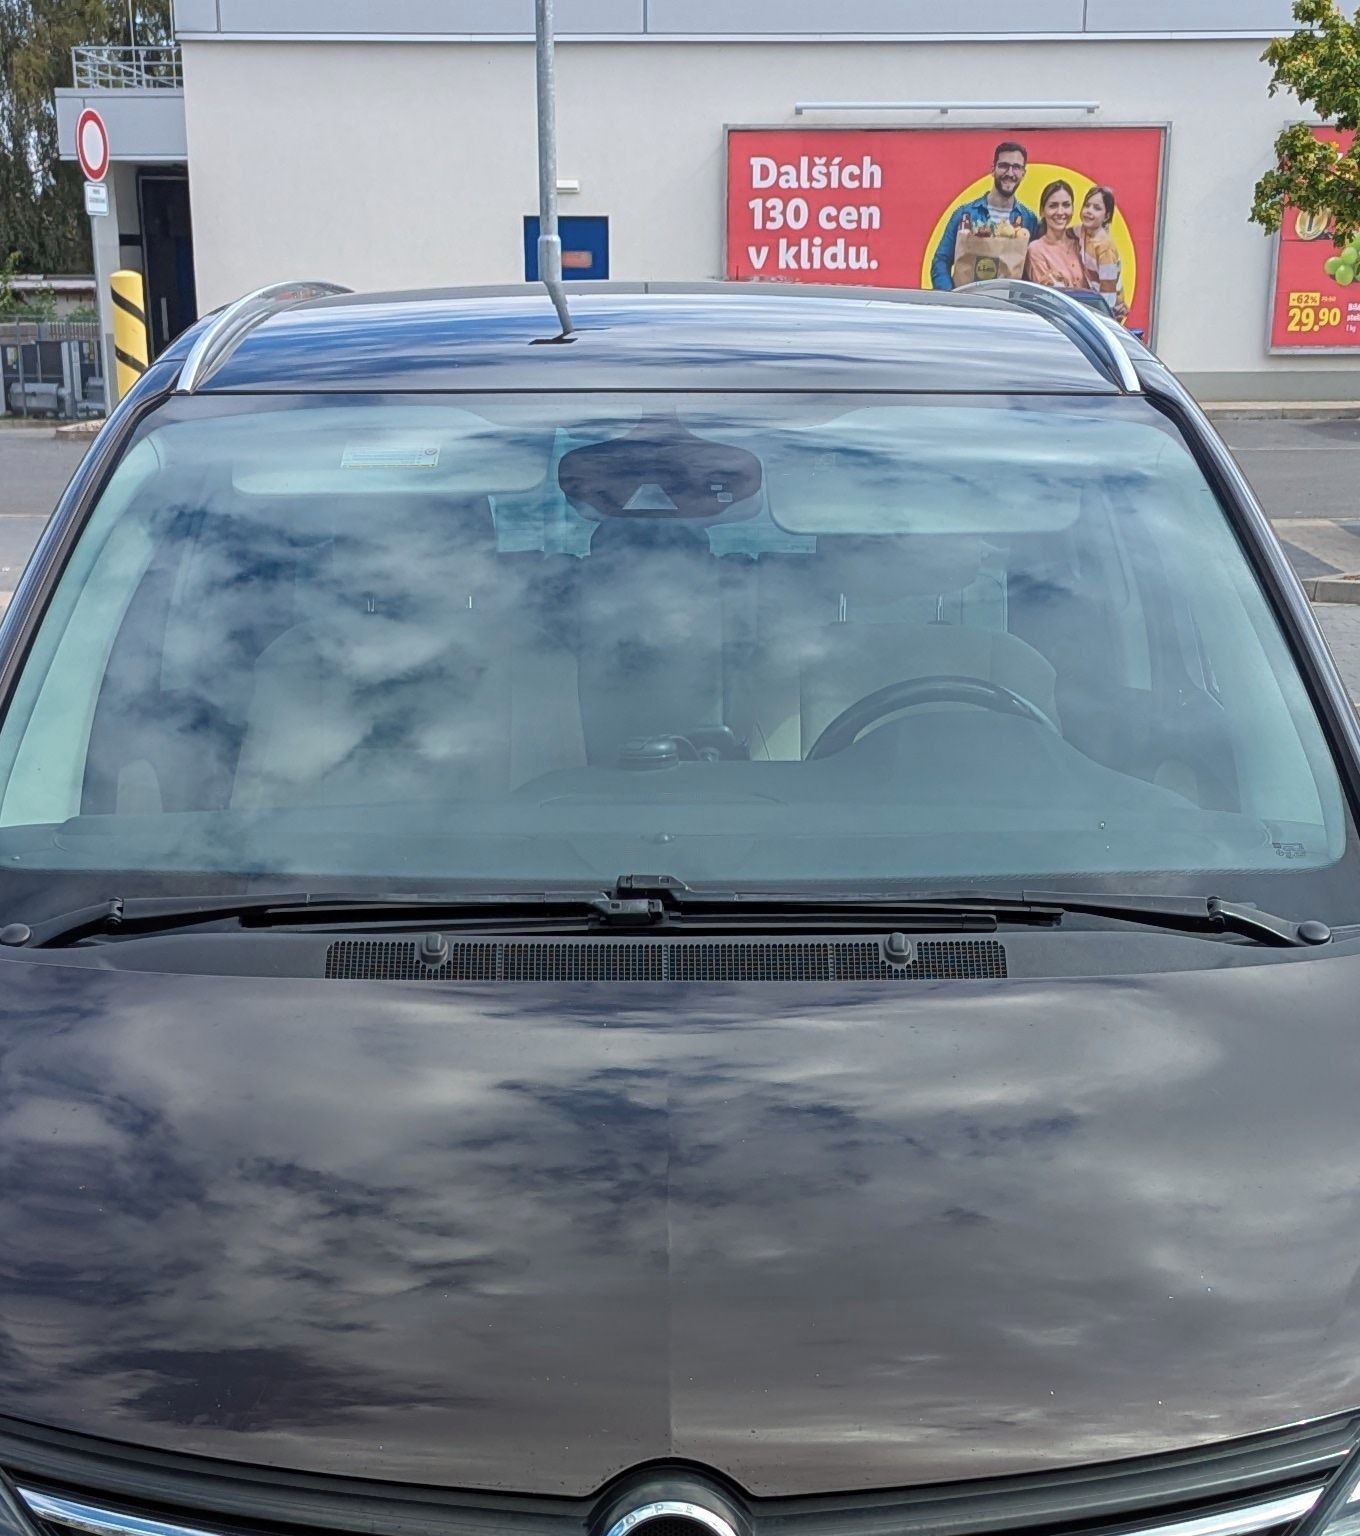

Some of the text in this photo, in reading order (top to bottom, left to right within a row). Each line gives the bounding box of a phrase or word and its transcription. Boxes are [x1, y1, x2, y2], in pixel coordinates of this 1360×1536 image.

[750, 156, 882, 189] Dalších
[749, 197, 881, 230] 130 cen
[748, 236, 879, 270] v klidu.
[1292, 294, 1318, 305] -62%
[1287, 307, 1341, 332] 29.90
